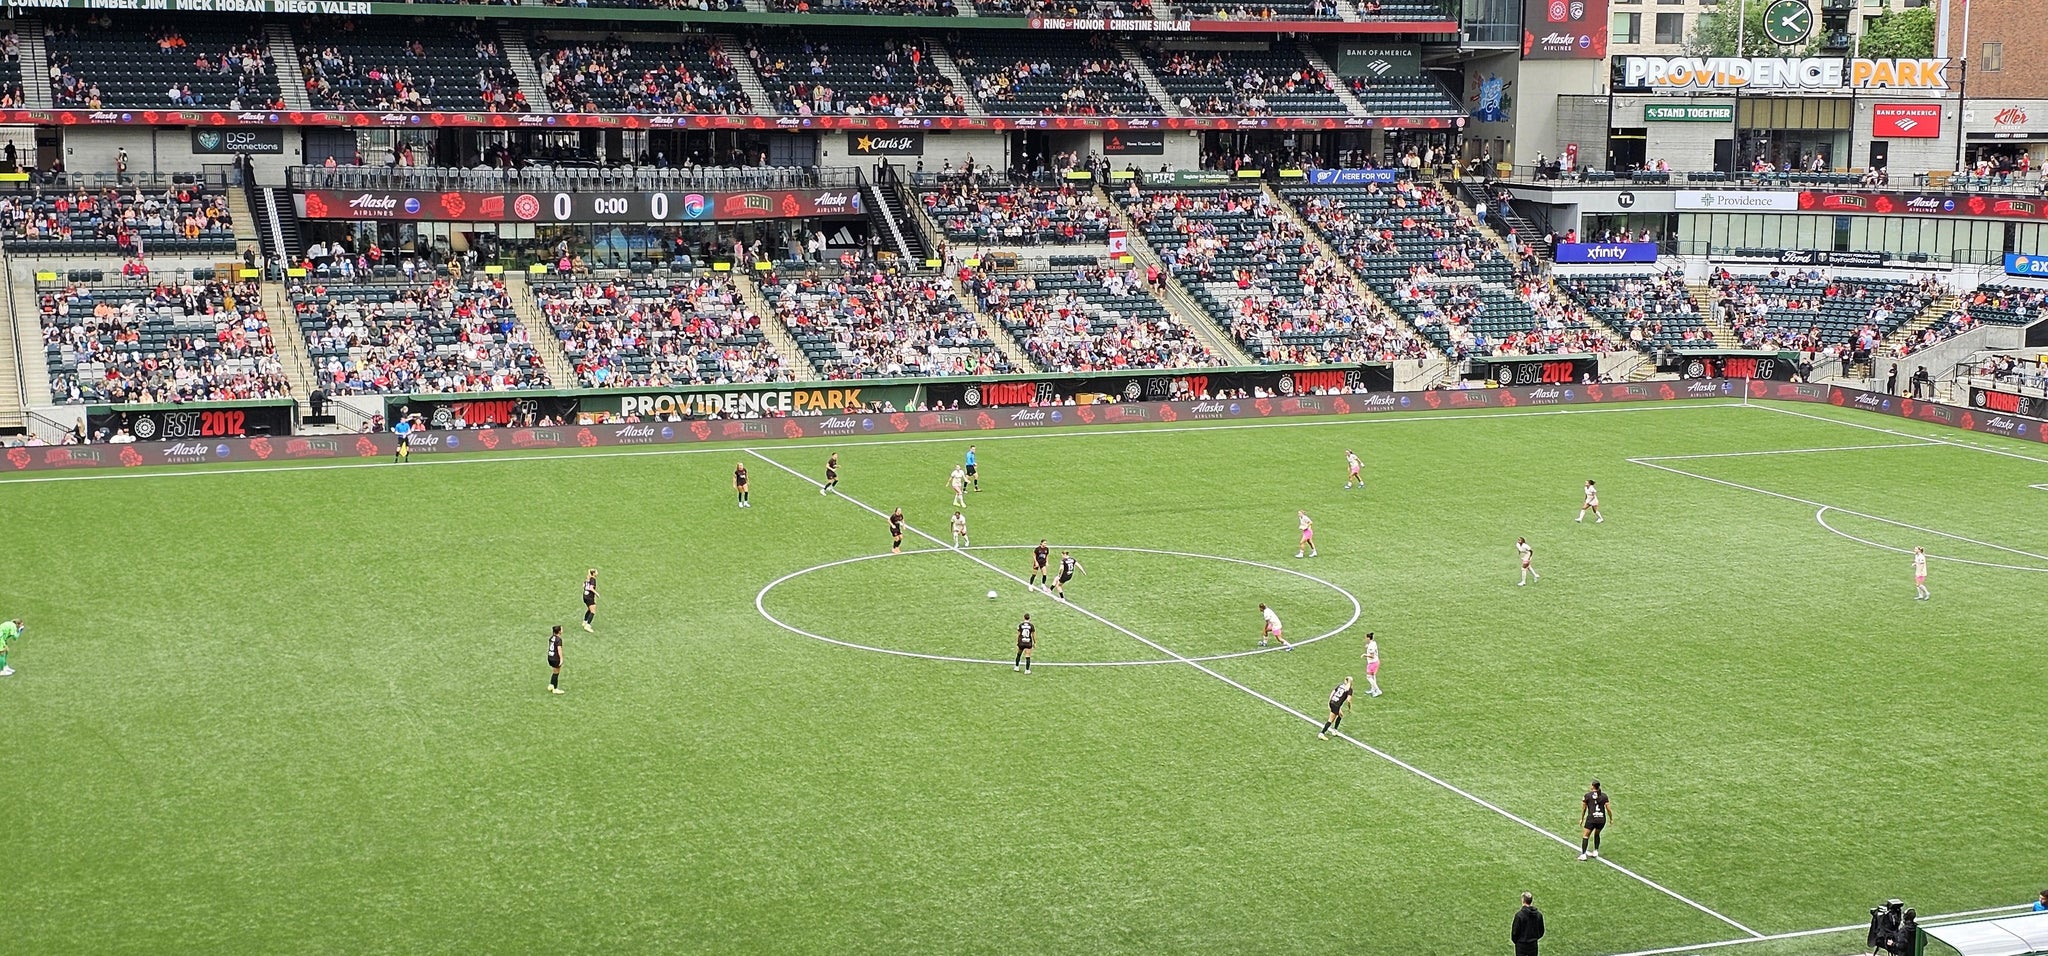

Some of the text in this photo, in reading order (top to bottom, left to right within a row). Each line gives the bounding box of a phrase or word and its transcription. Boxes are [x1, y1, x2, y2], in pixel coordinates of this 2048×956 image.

[84, 0, 138, 9] TIMBER
[141, 0, 167, 9] JIM
[176, 0, 212, 11] MICK
[216, 0, 265, 12] HOBAN
[274, 1, 317, 13] DIEGO
[321, 2, 371, 14] VALERI
[1044, 18, 1065, 29] RING
[1073, 19, 1105, 30] HONOR
[1110, 20, 1152, 31] CHRISTINE
[1153, 21, 1191, 31] SINCLAIR
[1541, 32, 1575, 45] Alaska
[1379, 49, 1412, 57] AMERICA
[1626, 57, 1951, 89] PROVIDENCE PARK
[89, 111, 118, 119] Alaska
[1657, 107, 1730, 118] STAND TOGETHER
[1994, 108, 2029, 128] Killer
[226, 132, 256, 143] DSP
[871, 138, 913, 150] Carl's Jr.
[1153, 173, 1175, 181] PTFC
[350, 194, 397, 209] Alaska
[814, 192, 847, 206] Alaska
[1620, 196, 1633, 204] TL
[1717, 196, 1773, 206] Providence
[1907, 196, 1940, 208] Alaska
[554, 193, 669, 220] 0 0:00 0
[1587, 246, 1627, 259] xfinity
[1781, 251, 1812, 263] Ford
[1829, 256, 1880, 264] BuyFordNow.com
[1516, 361, 1574, 384] EST. 2012
[1754, 359, 1774, 380] FC
[1294, 370, 1361, 393] THORNS FC
[1687, 382, 1718, 392] Alaska
[981, 382, 1053, 405] THORNS FC
[1364, 394, 1395, 406] Alaska
[1529, 388, 1560, 399] Alaska
[1854, 393, 1880, 405] Alaska
[622, 389, 863, 417] PROVIDENCE PARK
[1191, 402, 1225, 413] Alaska
[1985, 391, 2029, 415] THORNS FC
[452, 400, 514, 425] THORNS
[1011, 409, 1046, 421] Alaska
[162, 412, 200, 438] EST.
[201, 411, 246, 436] 2012
[819, 416, 856, 429] Alaska
[1986, 416, 2015, 430] Alaska
[616, 425, 655, 437] Alaska
[164, 443, 209, 456] Alaska
